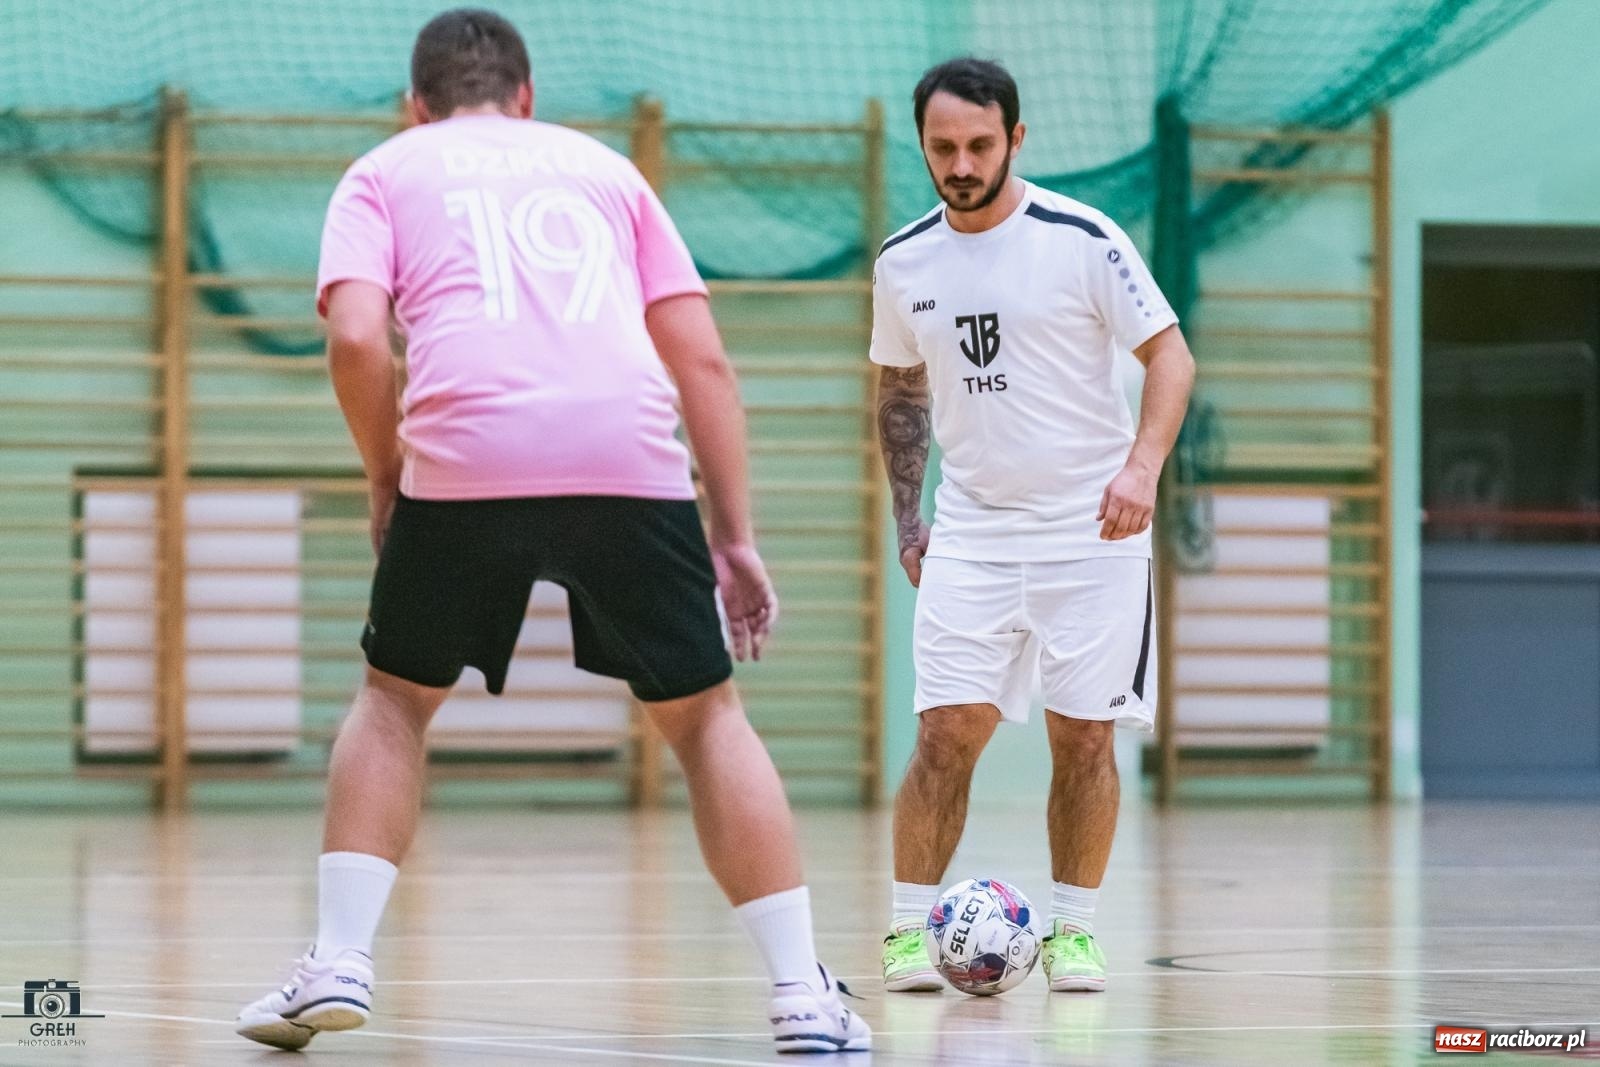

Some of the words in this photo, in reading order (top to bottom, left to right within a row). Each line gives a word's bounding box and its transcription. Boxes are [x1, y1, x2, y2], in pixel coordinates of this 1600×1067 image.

[442, 187, 614, 321] 19
[912, 299, 936, 313] JAKO
[955, 312, 1001, 369] JB
[962, 374, 1008, 394] THS
[950, 895, 985, 956] SELECT
